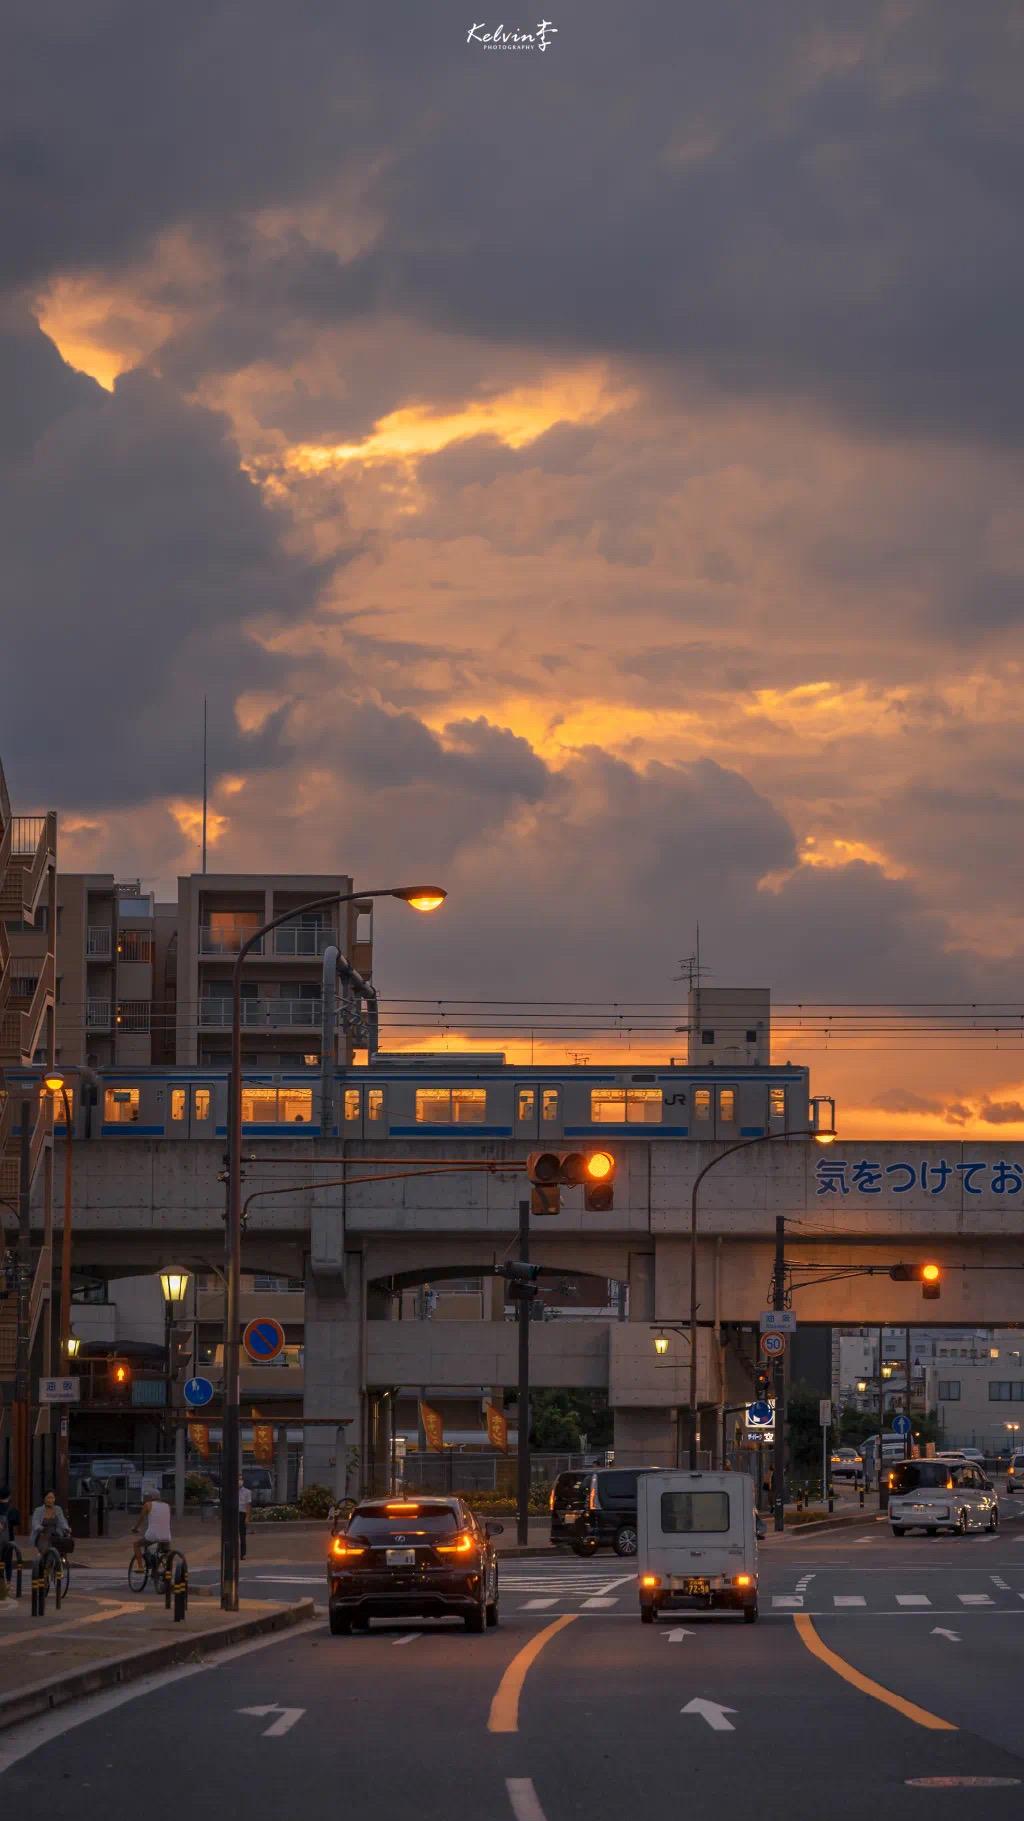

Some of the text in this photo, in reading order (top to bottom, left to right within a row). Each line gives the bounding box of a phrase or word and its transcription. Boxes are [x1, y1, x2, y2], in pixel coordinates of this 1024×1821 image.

[664, 1093, 686, 1106] JR
[816, 1158, 1024, 1195] 気をつけてお
[767, 1338, 780, 1349] 50
